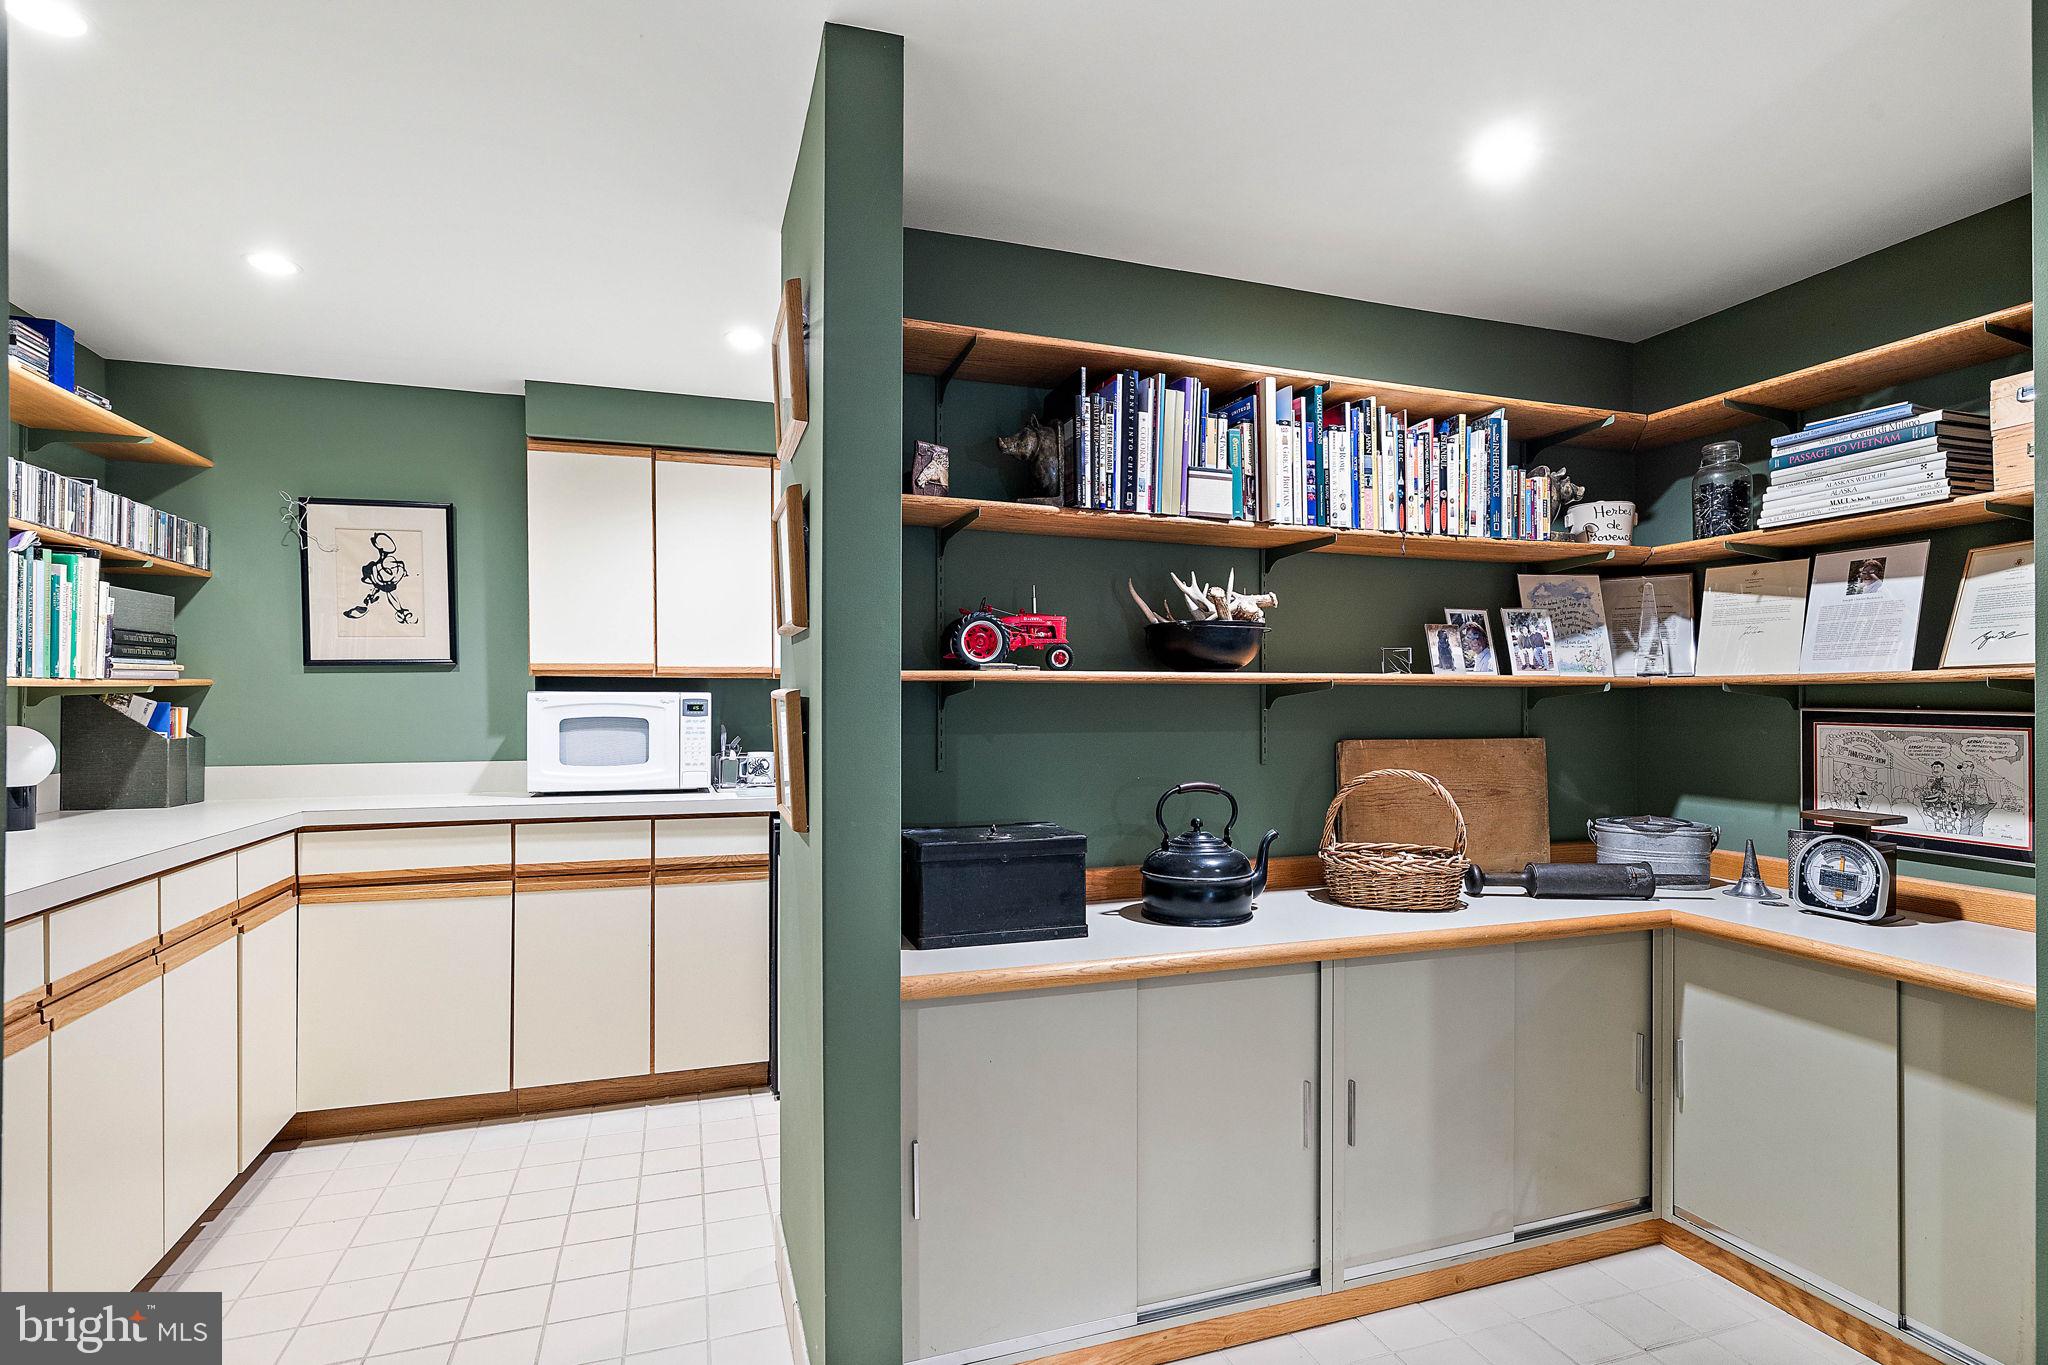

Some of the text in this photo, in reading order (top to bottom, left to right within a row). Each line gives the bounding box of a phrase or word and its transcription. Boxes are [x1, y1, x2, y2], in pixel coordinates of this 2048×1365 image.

[1789, 448, 1830, 464] PASSAGE
[1833, 444, 1847, 454] TO
[1850, 434, 1900, 450] VIETNAM
[1856, 472, 1887, 482] WILDLIFE
[1831, 486, 1858, 496] ALASKA
[1594, 505, 1631, 519] Herbes
[1606, 520, 1622, 530] de
